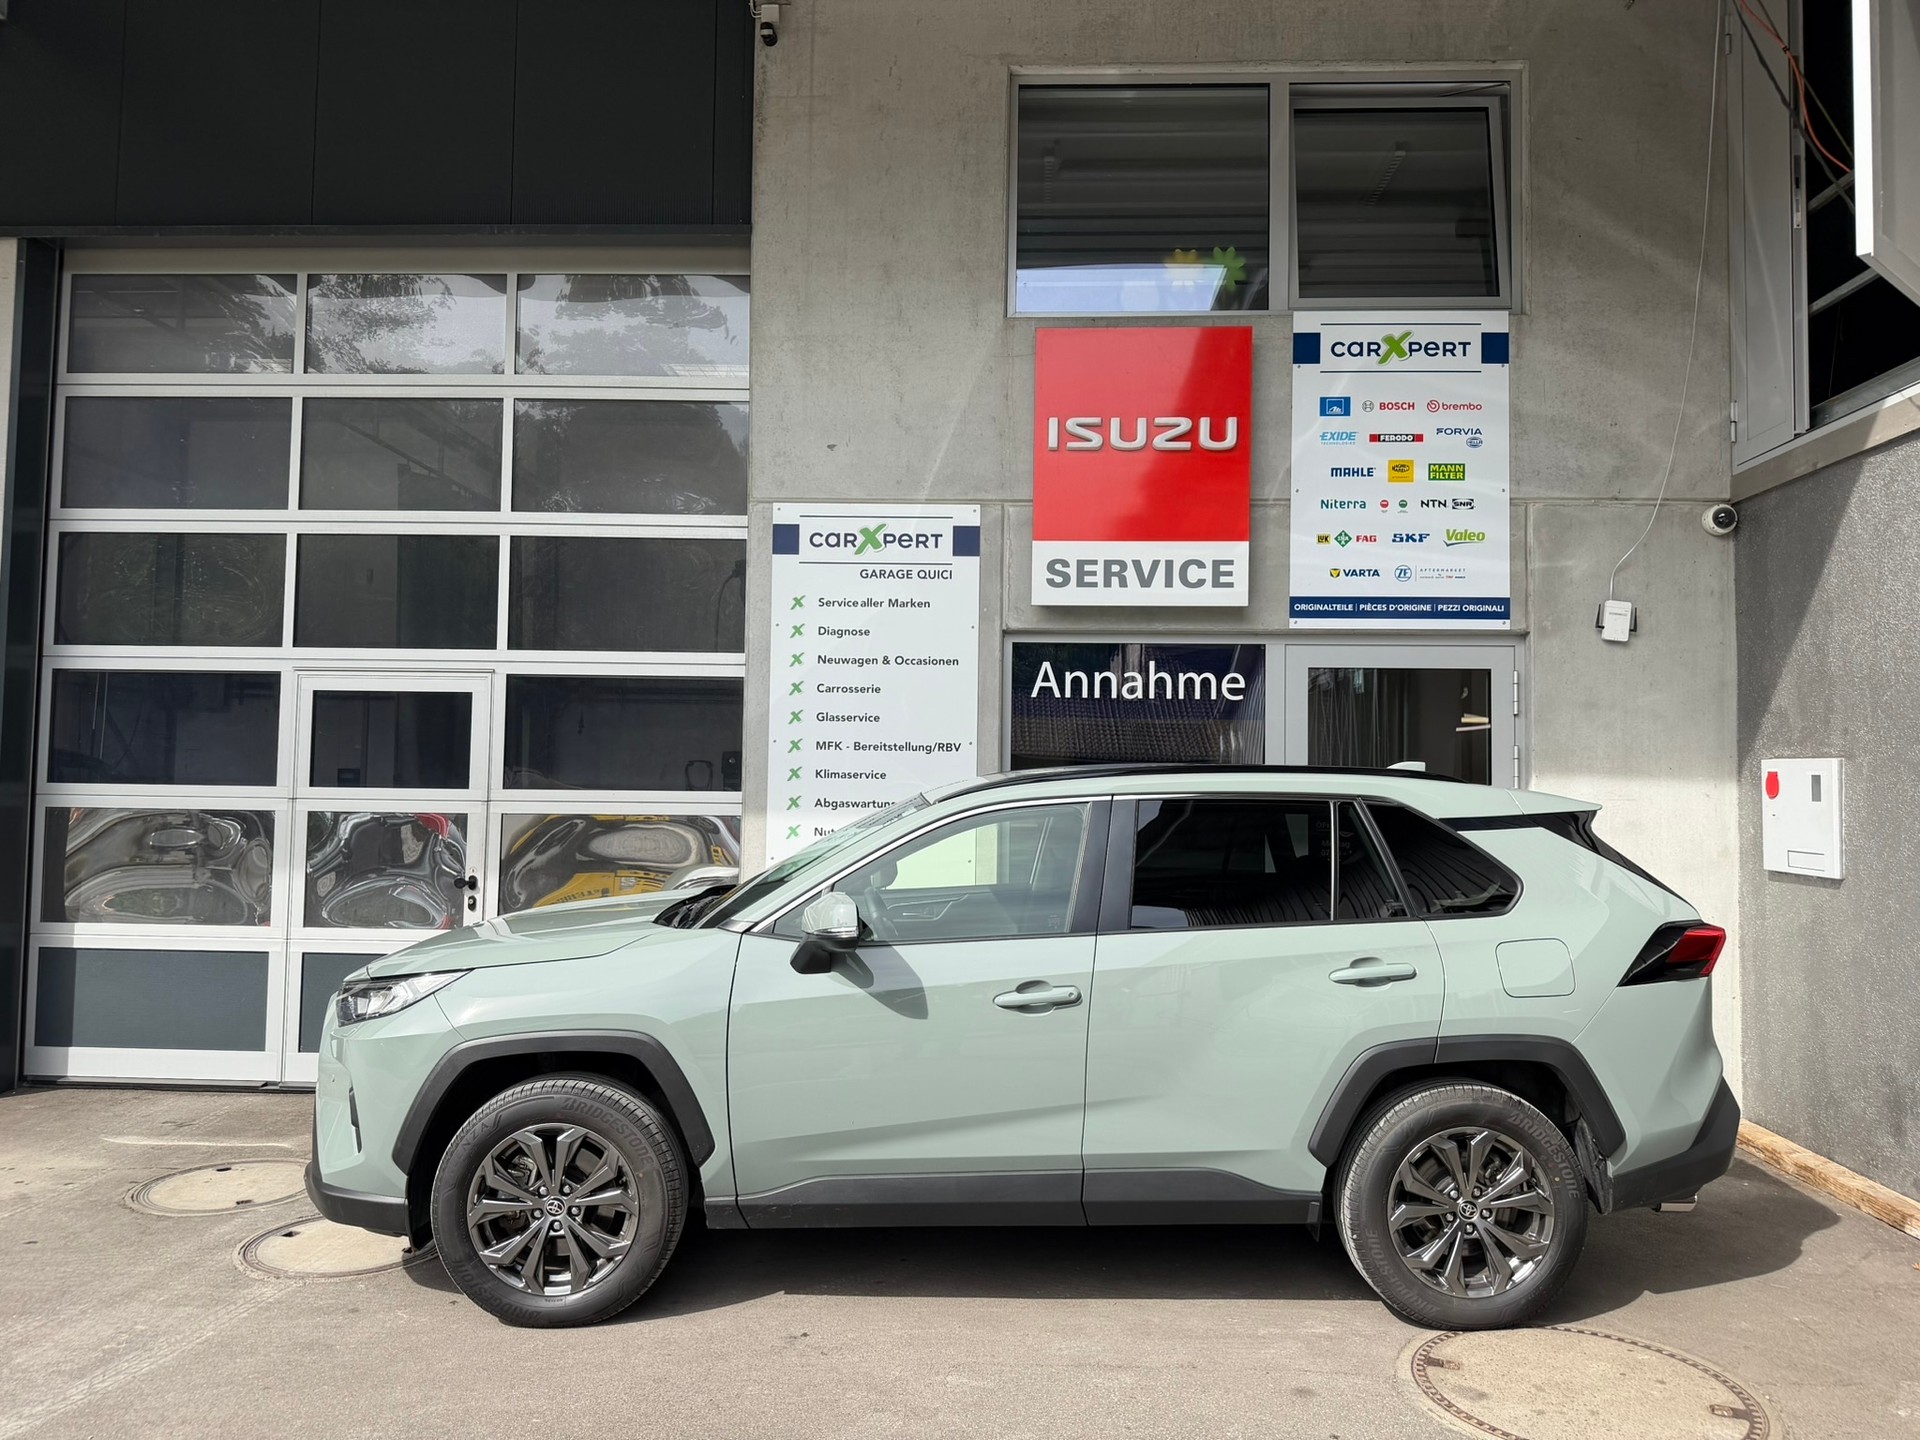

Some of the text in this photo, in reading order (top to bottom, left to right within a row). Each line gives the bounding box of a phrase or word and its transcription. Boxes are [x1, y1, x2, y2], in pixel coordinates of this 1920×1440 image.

[1379, 401, 1416, 411] BOSCH
[1441, 401, 1483, 411] brembo
[1047, 416, 1239, 451] ISUZU
[1319, 431, 1358, 441] EXIDE
[1435, 427, 1483, 436] FORVIA
[1379, 434, 1414, 442] FERODO
[1330, 466, 1374, 478] MAHLE
[1430, 464, 1464, 472] MANN
[1430, 471, 1464, 480] FILTER
[1320, 498, 1367, 510] Niterra
[1420, 499, 1447, 509] NTN
[1355, 534, 1377, 543] FAG
[1391, 533, 1431, 543] SKF
[1445, 528, 1486, 542] Valeo
[859, 568, 953, 580] GARAGE QUICI
[1045, 558, 1235, 589] SERVICE
[1342, 568, 1381, 578] VARTA
[818, 597, 931, 609] Service aller Marken
[1293, 602, 1505, 612] ORIGINALTEILE PIÈCES D'ORIGINE PEZZI ORIGINALI
[817, 626, 871, 639] Diagnose
[817, 654, 959, 668] Neuwagen & Occasionen
[1030, 659, 1246, 701] Annahme
[816, 683, 882, 694] Carrosserie
[815, 711, 881, 723] Glasservice
[815, 740, 843, 751] MFK
[853, 741, 962, 755] Bereitstellung/RBV
[815, 768, 887, 780] Klimaservice
